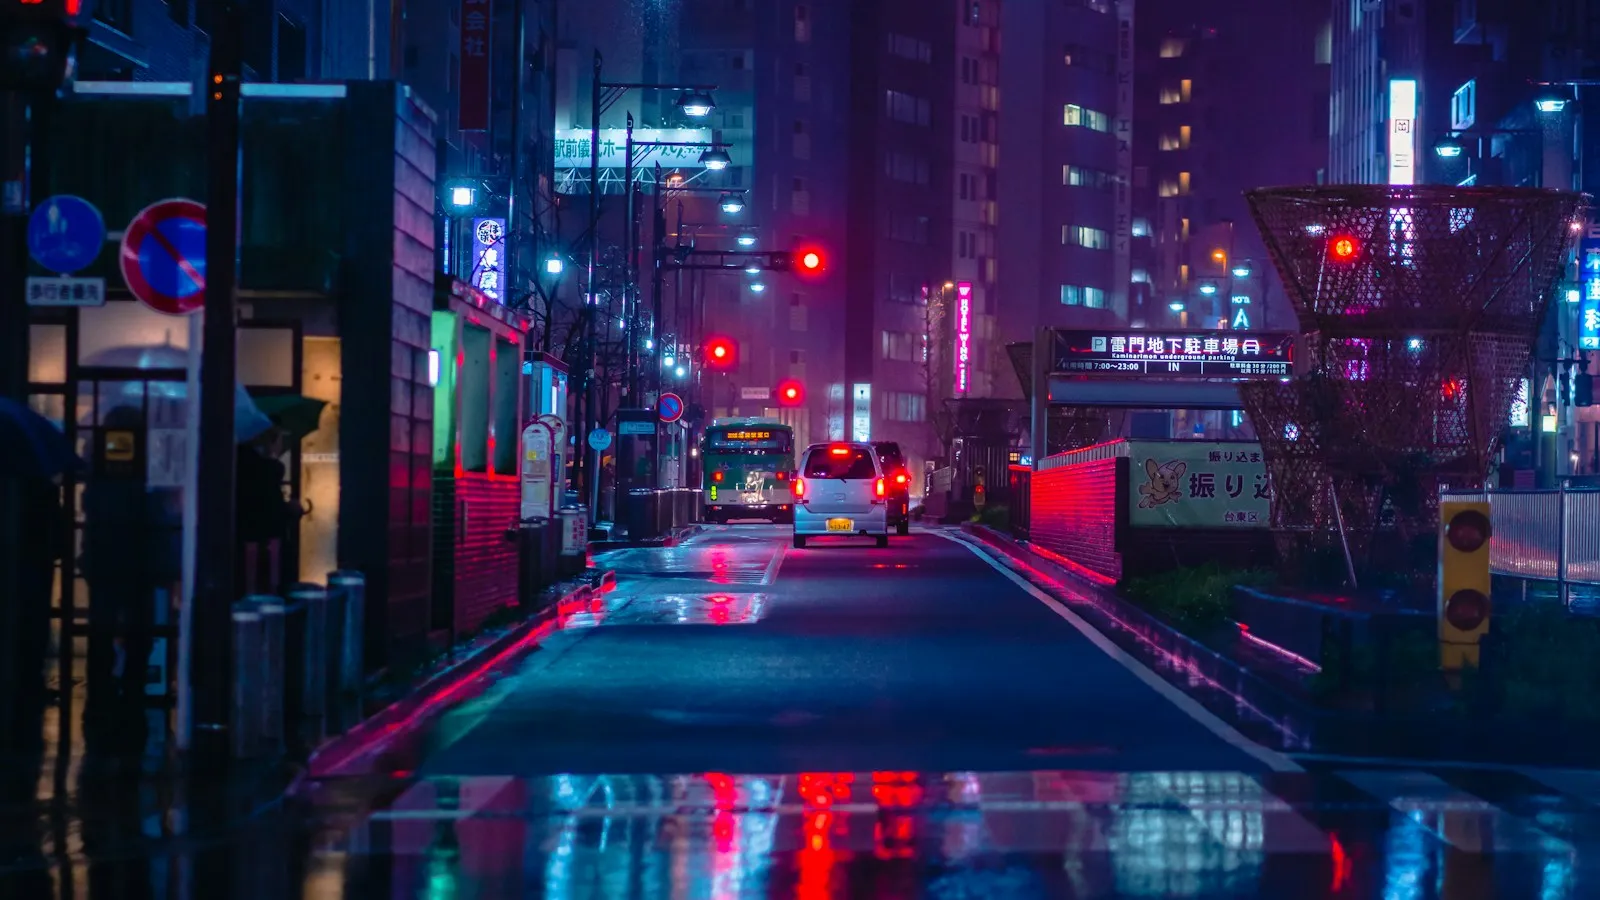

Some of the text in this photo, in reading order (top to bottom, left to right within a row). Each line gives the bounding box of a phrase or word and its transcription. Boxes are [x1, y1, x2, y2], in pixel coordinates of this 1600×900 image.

[1110, 336, 1238, 356] 雷門地下駐車場
[1168, 362, 1180, 372] IN
[1209, 451, 1264, 463] 振り込ま
[1224, 511, 1259, 522] 台東区
